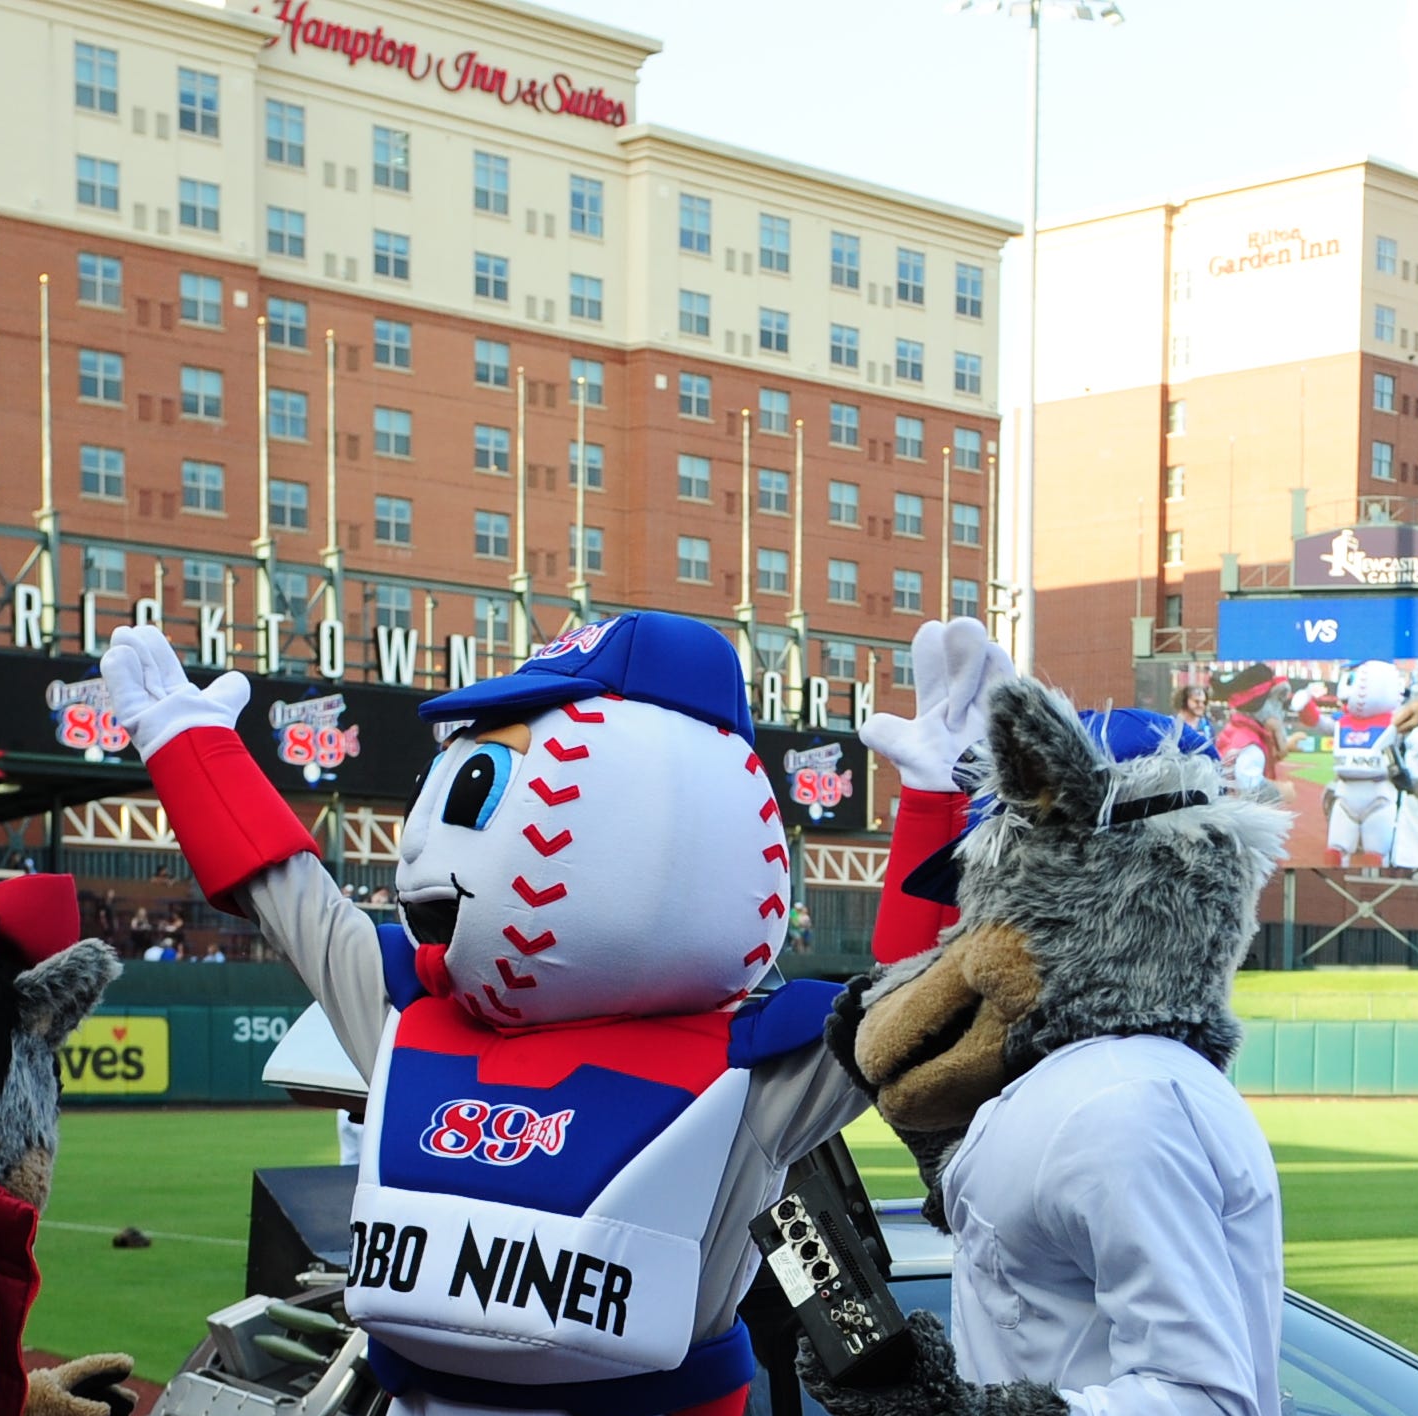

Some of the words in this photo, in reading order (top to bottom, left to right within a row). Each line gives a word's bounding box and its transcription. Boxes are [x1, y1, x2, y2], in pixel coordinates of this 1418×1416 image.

[256, 0, 432, 80] Hampton
[436, 52, 521, 105] Inn
[521, 79, 541, 112] &
[541, 72, 627, 127] Suites
[1209, 245, 1292, 277] Garden
[1300, 238, 1341, 260] Inn
[233, 1016, 288, 1042] 350
[60, 1045, 145, 1081] ves
[346, 1220, 428, 1293] OBO
[448, 1218, 632, 1337] NINER
